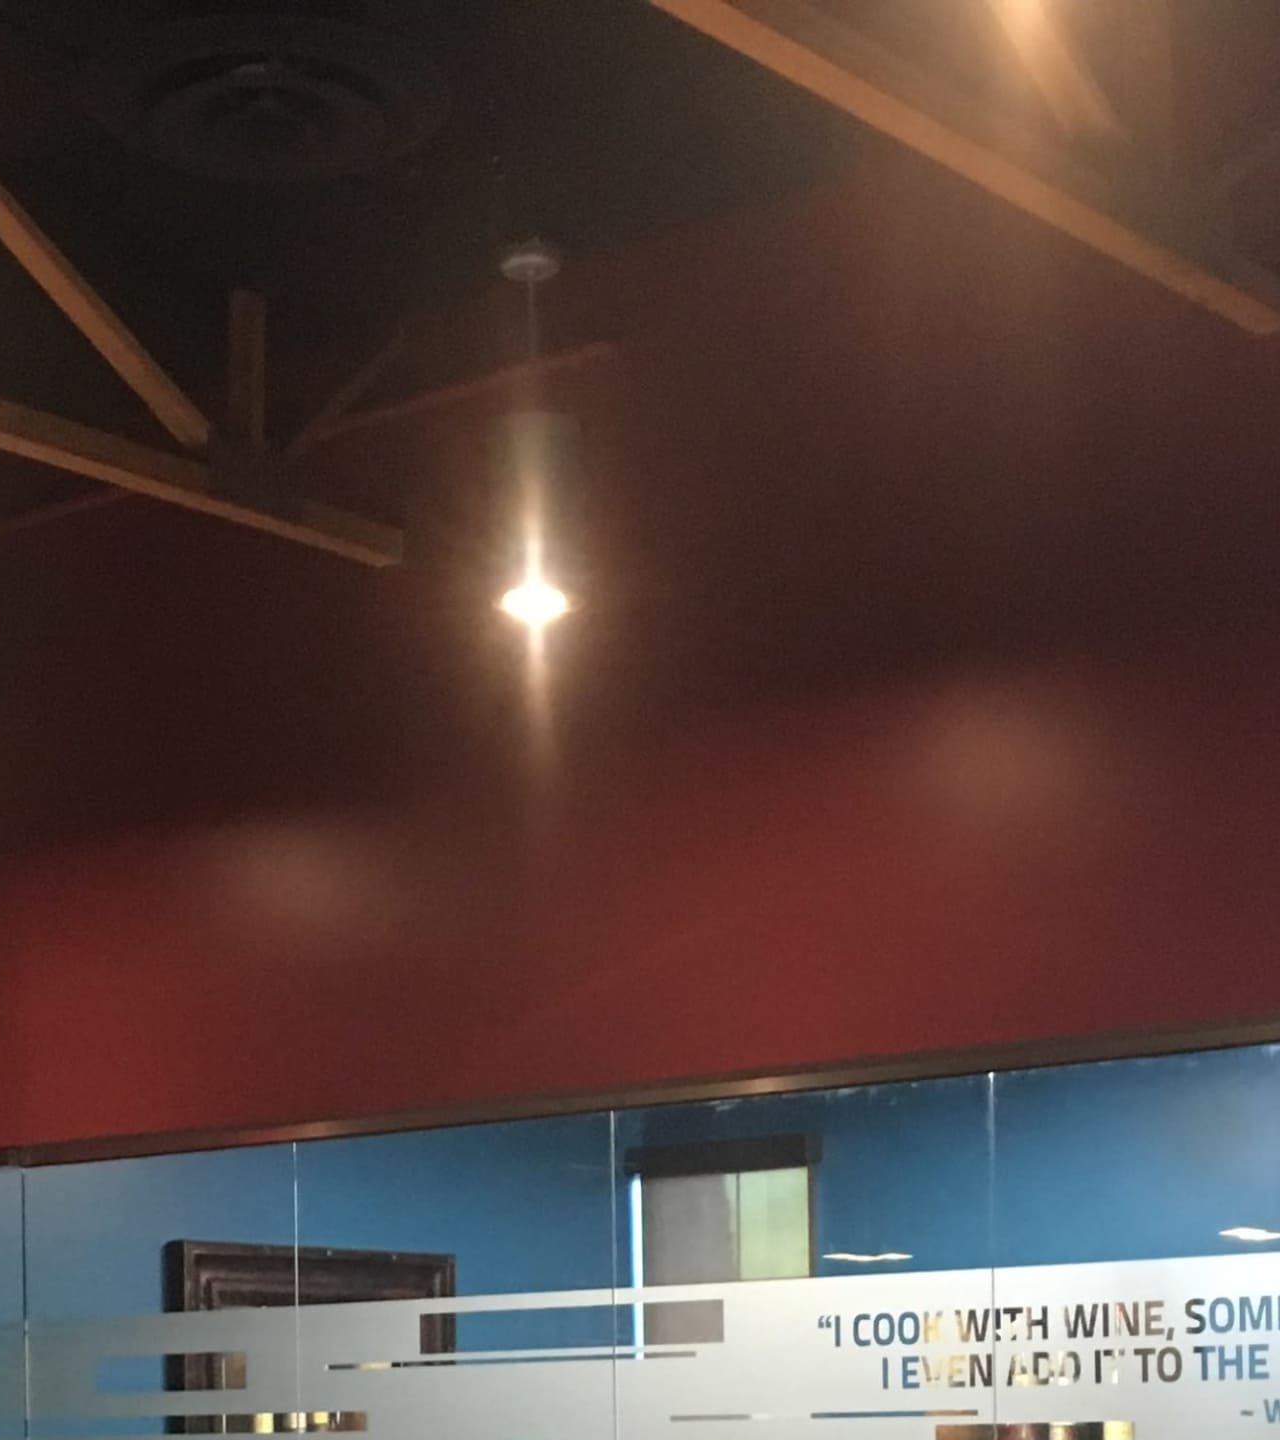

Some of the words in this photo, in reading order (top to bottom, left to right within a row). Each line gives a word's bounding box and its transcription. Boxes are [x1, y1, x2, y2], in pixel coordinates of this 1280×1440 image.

[853, 1310, 943, 1347] COOK
[955, 1305, 1048, 1343] WITH
[1065, 1299, 1174, 1341] WINE,
[881, 1356, 889, 1390] I
[902, 1353, 992, 1390] EVEN
[1006, 1351, 1081, 1387] ADD
[1094, 1348, 1125, 1384] IT
[1133, 1346, 1183, 1383] TO
[1193, 1343, 1270, 1381] THE
